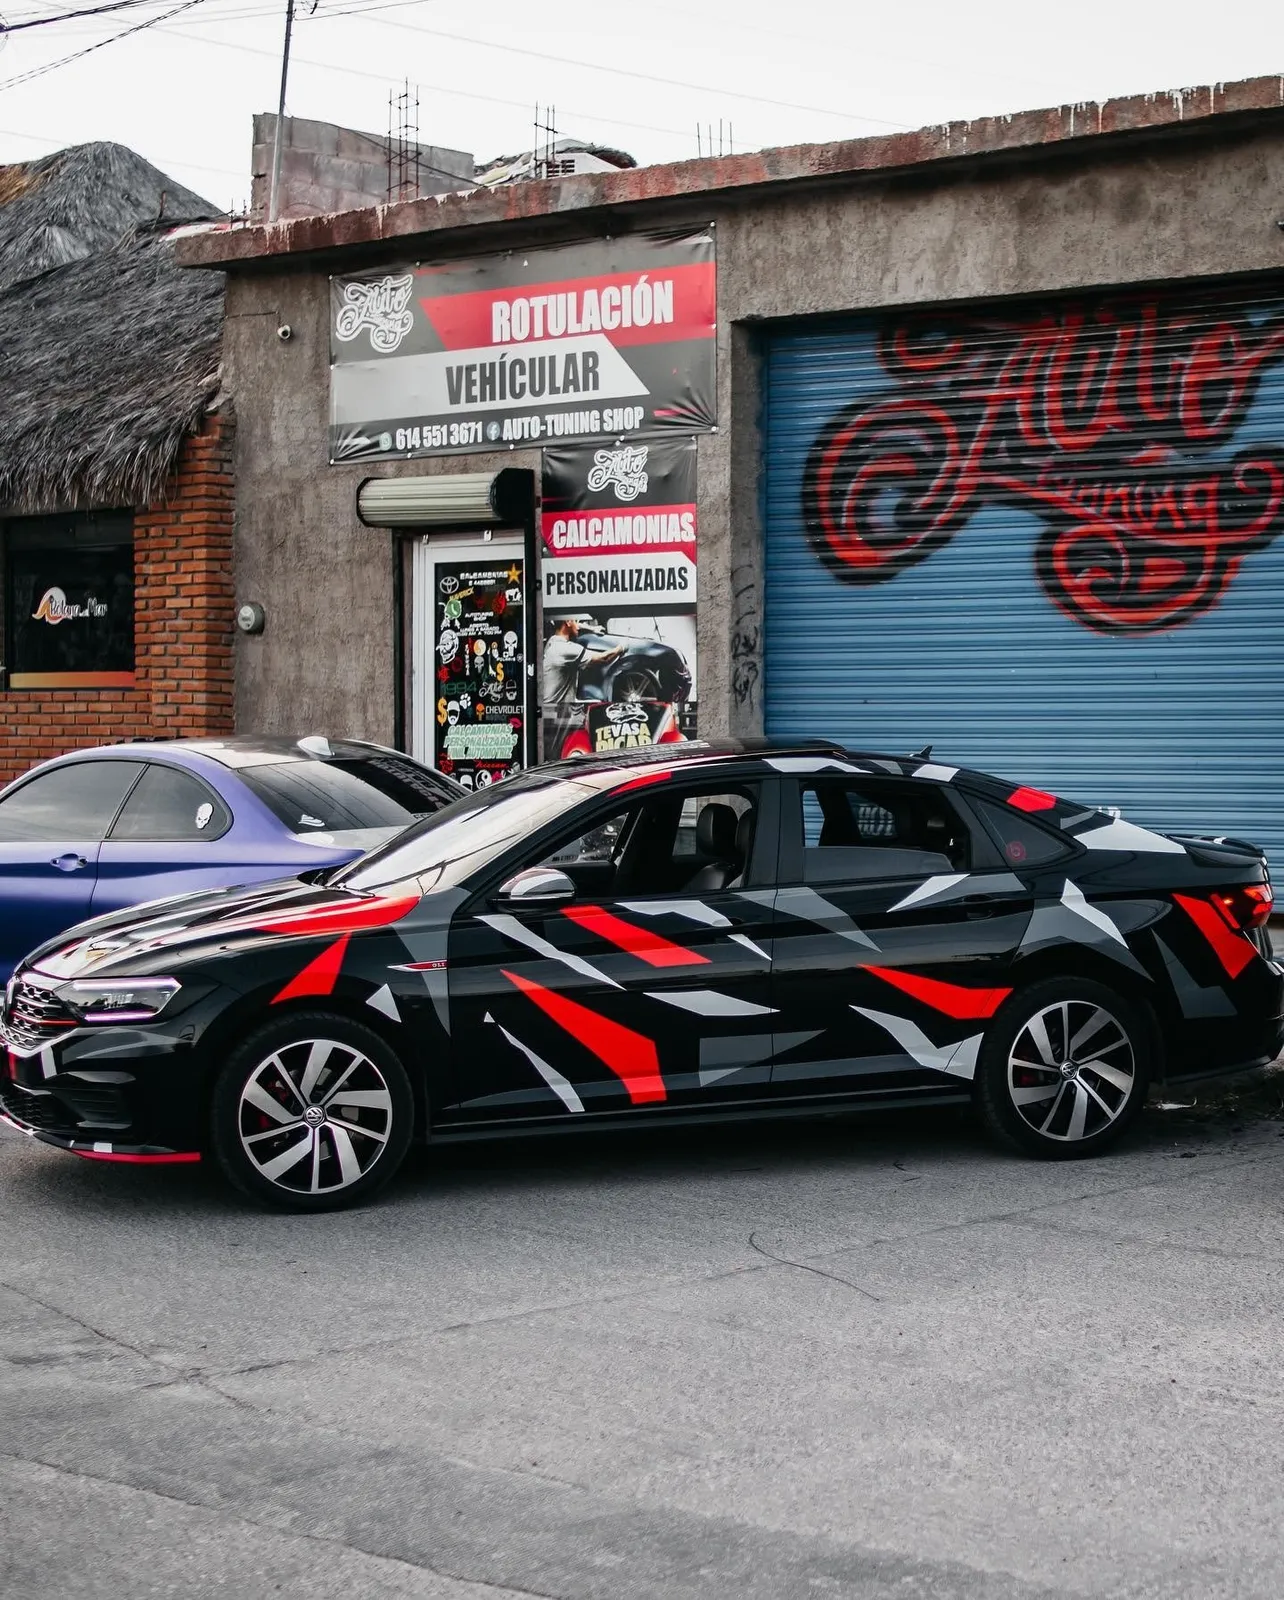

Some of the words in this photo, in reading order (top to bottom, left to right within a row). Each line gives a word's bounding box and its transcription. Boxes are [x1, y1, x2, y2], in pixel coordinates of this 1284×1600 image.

[492, 274, 674, 343] ROTULACIÓN
[445, 351, 600, 406] VEHÍCULAR
[395, 427, 421, 450] 614
[423, 424, 448, 448] 551
[449, 421, 483, 445] 3671
[502, 410, 600, 441] AUTO-TUNING
[603, 406, 645, 432] SHOP
[552, 512, 696, 549] CALCAMONIAS
[546, 566, 688, 596] PERSONALIZADAS
